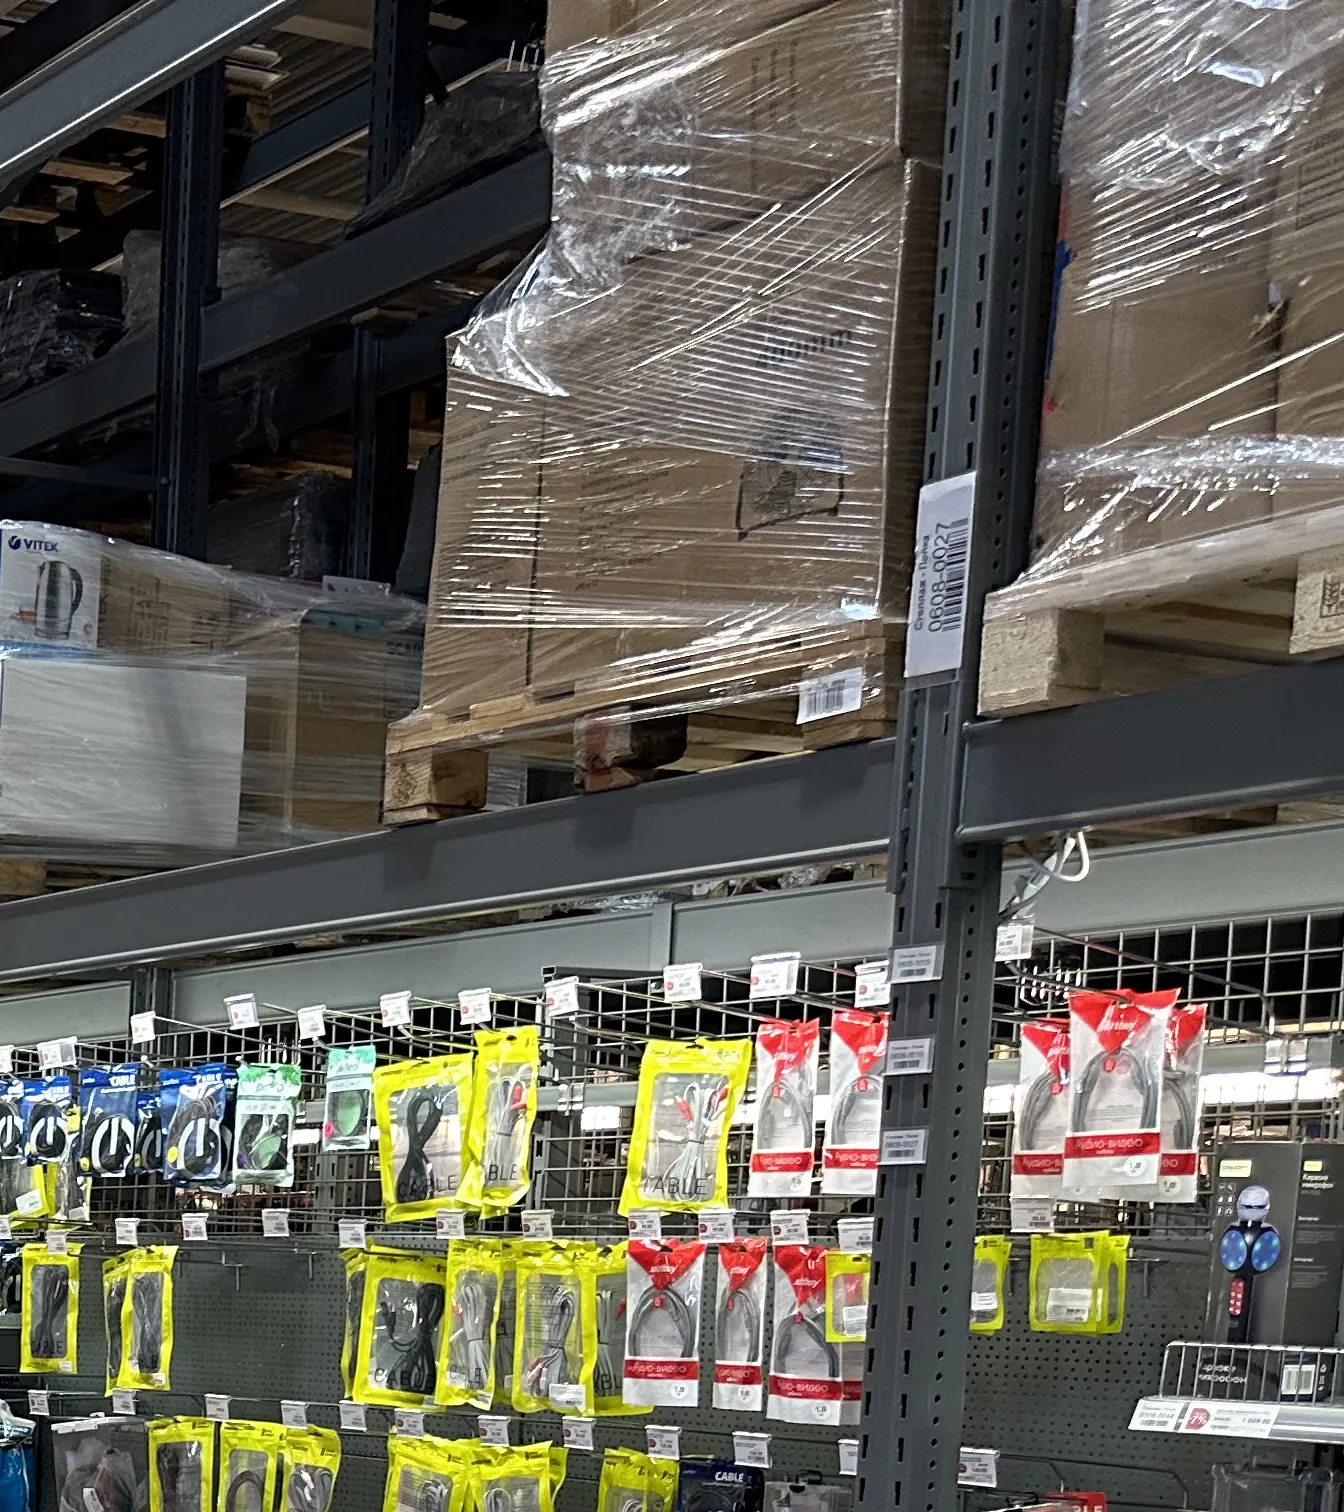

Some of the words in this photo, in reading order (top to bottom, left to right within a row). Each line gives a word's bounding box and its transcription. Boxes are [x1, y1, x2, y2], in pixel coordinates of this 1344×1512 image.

[24, 538, 59, 552] VITEK
[928, 523, 950, 632] 0608-0027
[715, 1471, 744, 1483] CABLE
